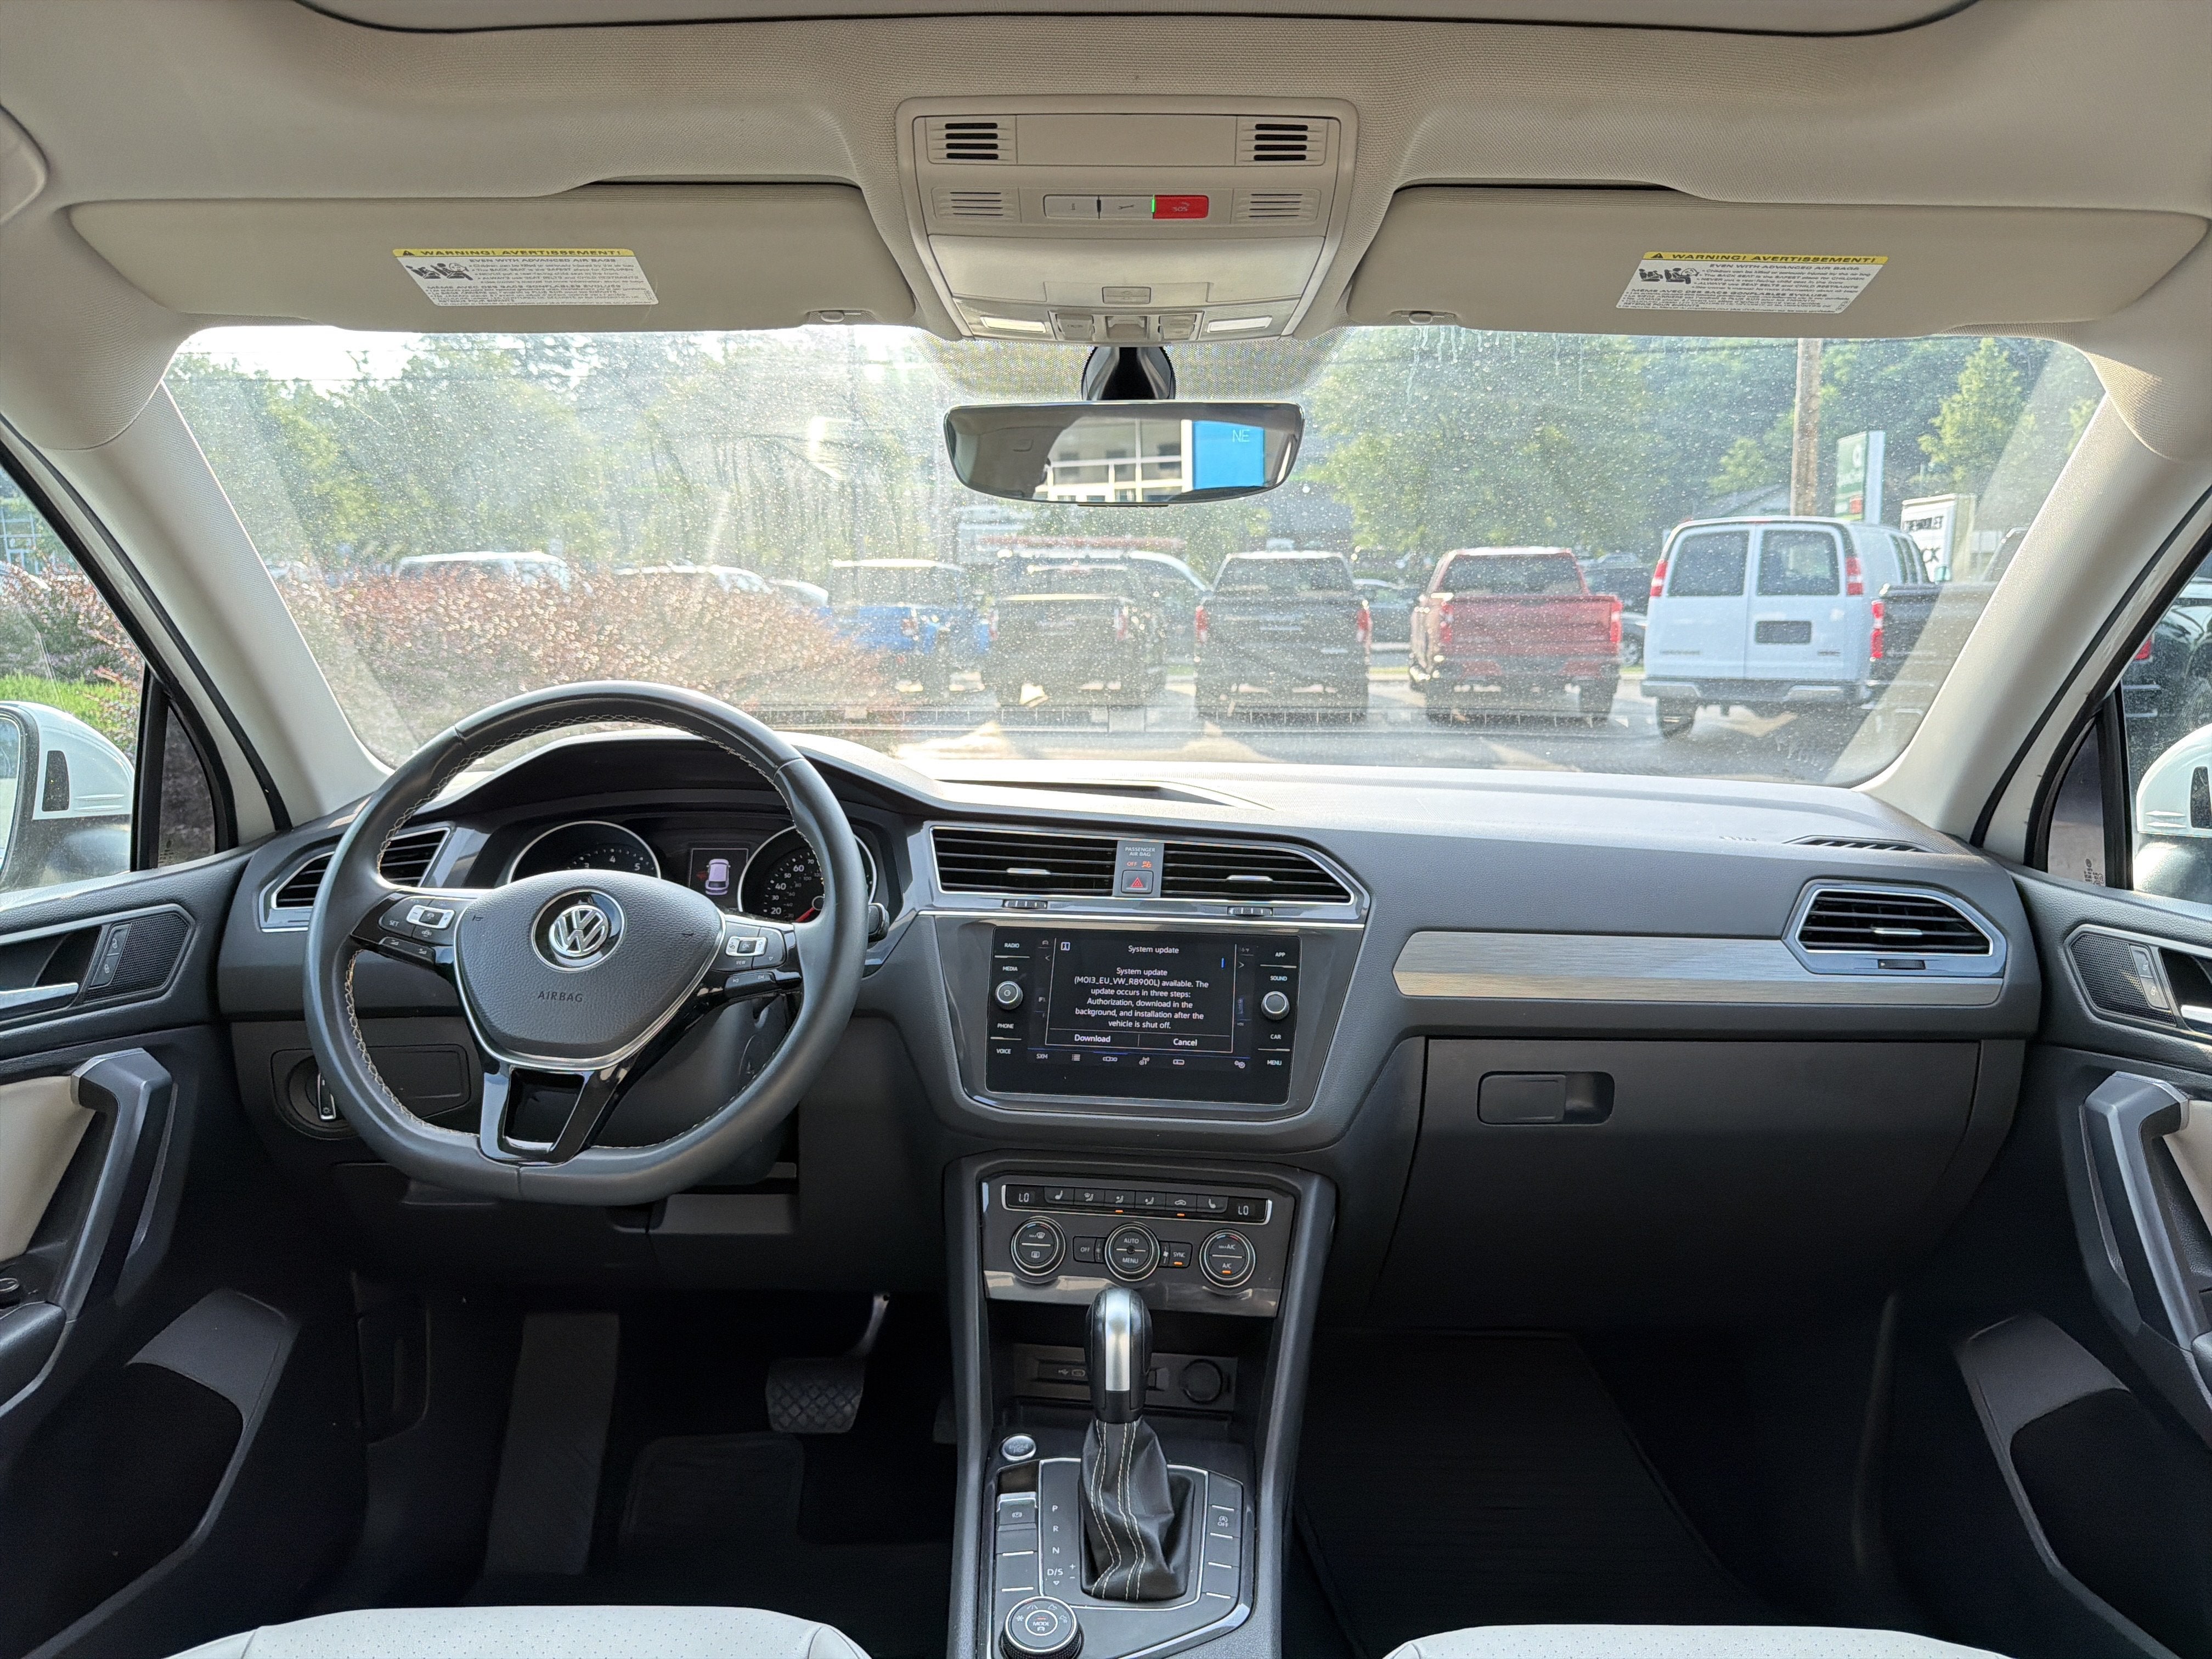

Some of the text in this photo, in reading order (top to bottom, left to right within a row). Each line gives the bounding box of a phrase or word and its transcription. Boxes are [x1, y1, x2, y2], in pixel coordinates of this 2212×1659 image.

[1232, 428, 1250, 443] NE
[634, 862, 640, 871] 5
[1128, 945, 1153, 953] System
[1116, 967, 1167, 977] System update
[538, 991, 583, 1002] AIRBAG
[1091, 988, 1115, 996] update
[1087, 997, 1134, 1007] Authorization,
[1136, 999, 1171, 1007] download
[1075, 1008, 1118, 1017] background,
[1134, 1010, 1172, 1018] installation
[1108, 1019, 1132, 1028] vehicle
[1074, 1034, 1198, 1046] Download Cancel
[1018, 1193, 1029, 1203] LO
[1238, 1205, 1249, 1216] LO
